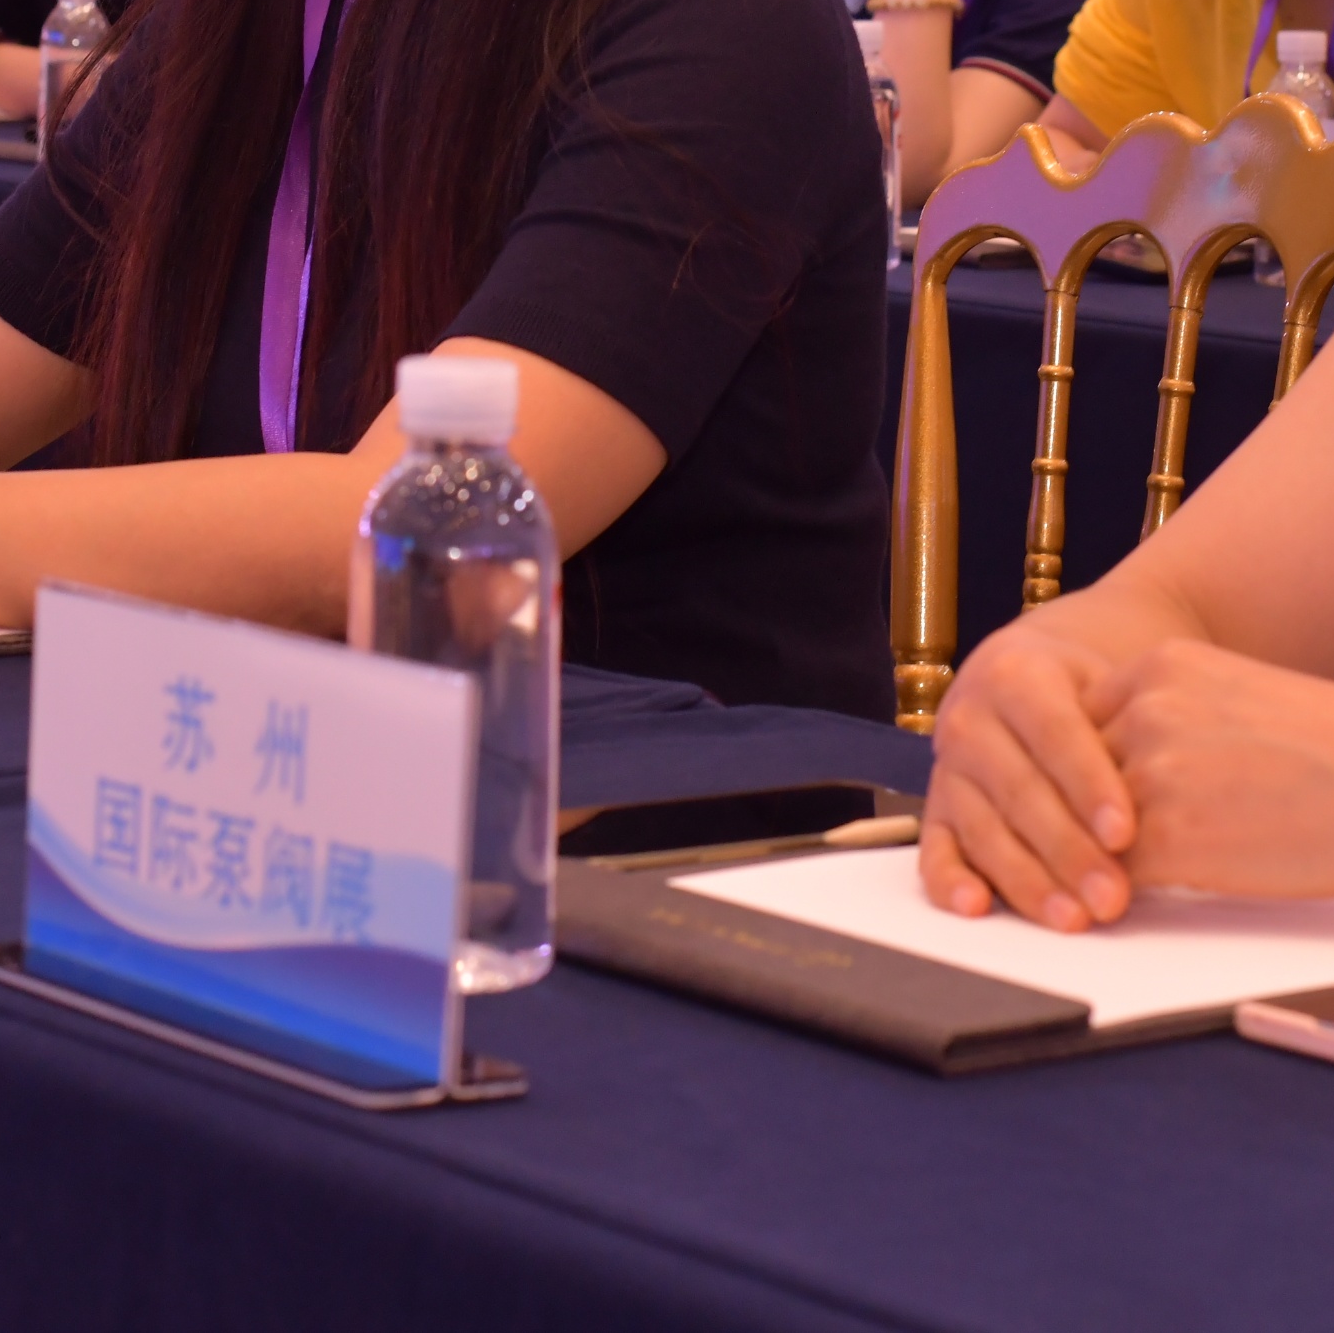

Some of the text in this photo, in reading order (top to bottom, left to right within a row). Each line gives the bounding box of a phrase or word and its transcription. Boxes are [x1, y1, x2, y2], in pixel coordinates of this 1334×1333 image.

[160, 673, 311, 807] 苏州
[92, 776, 377, 945] 国际泵阀展
